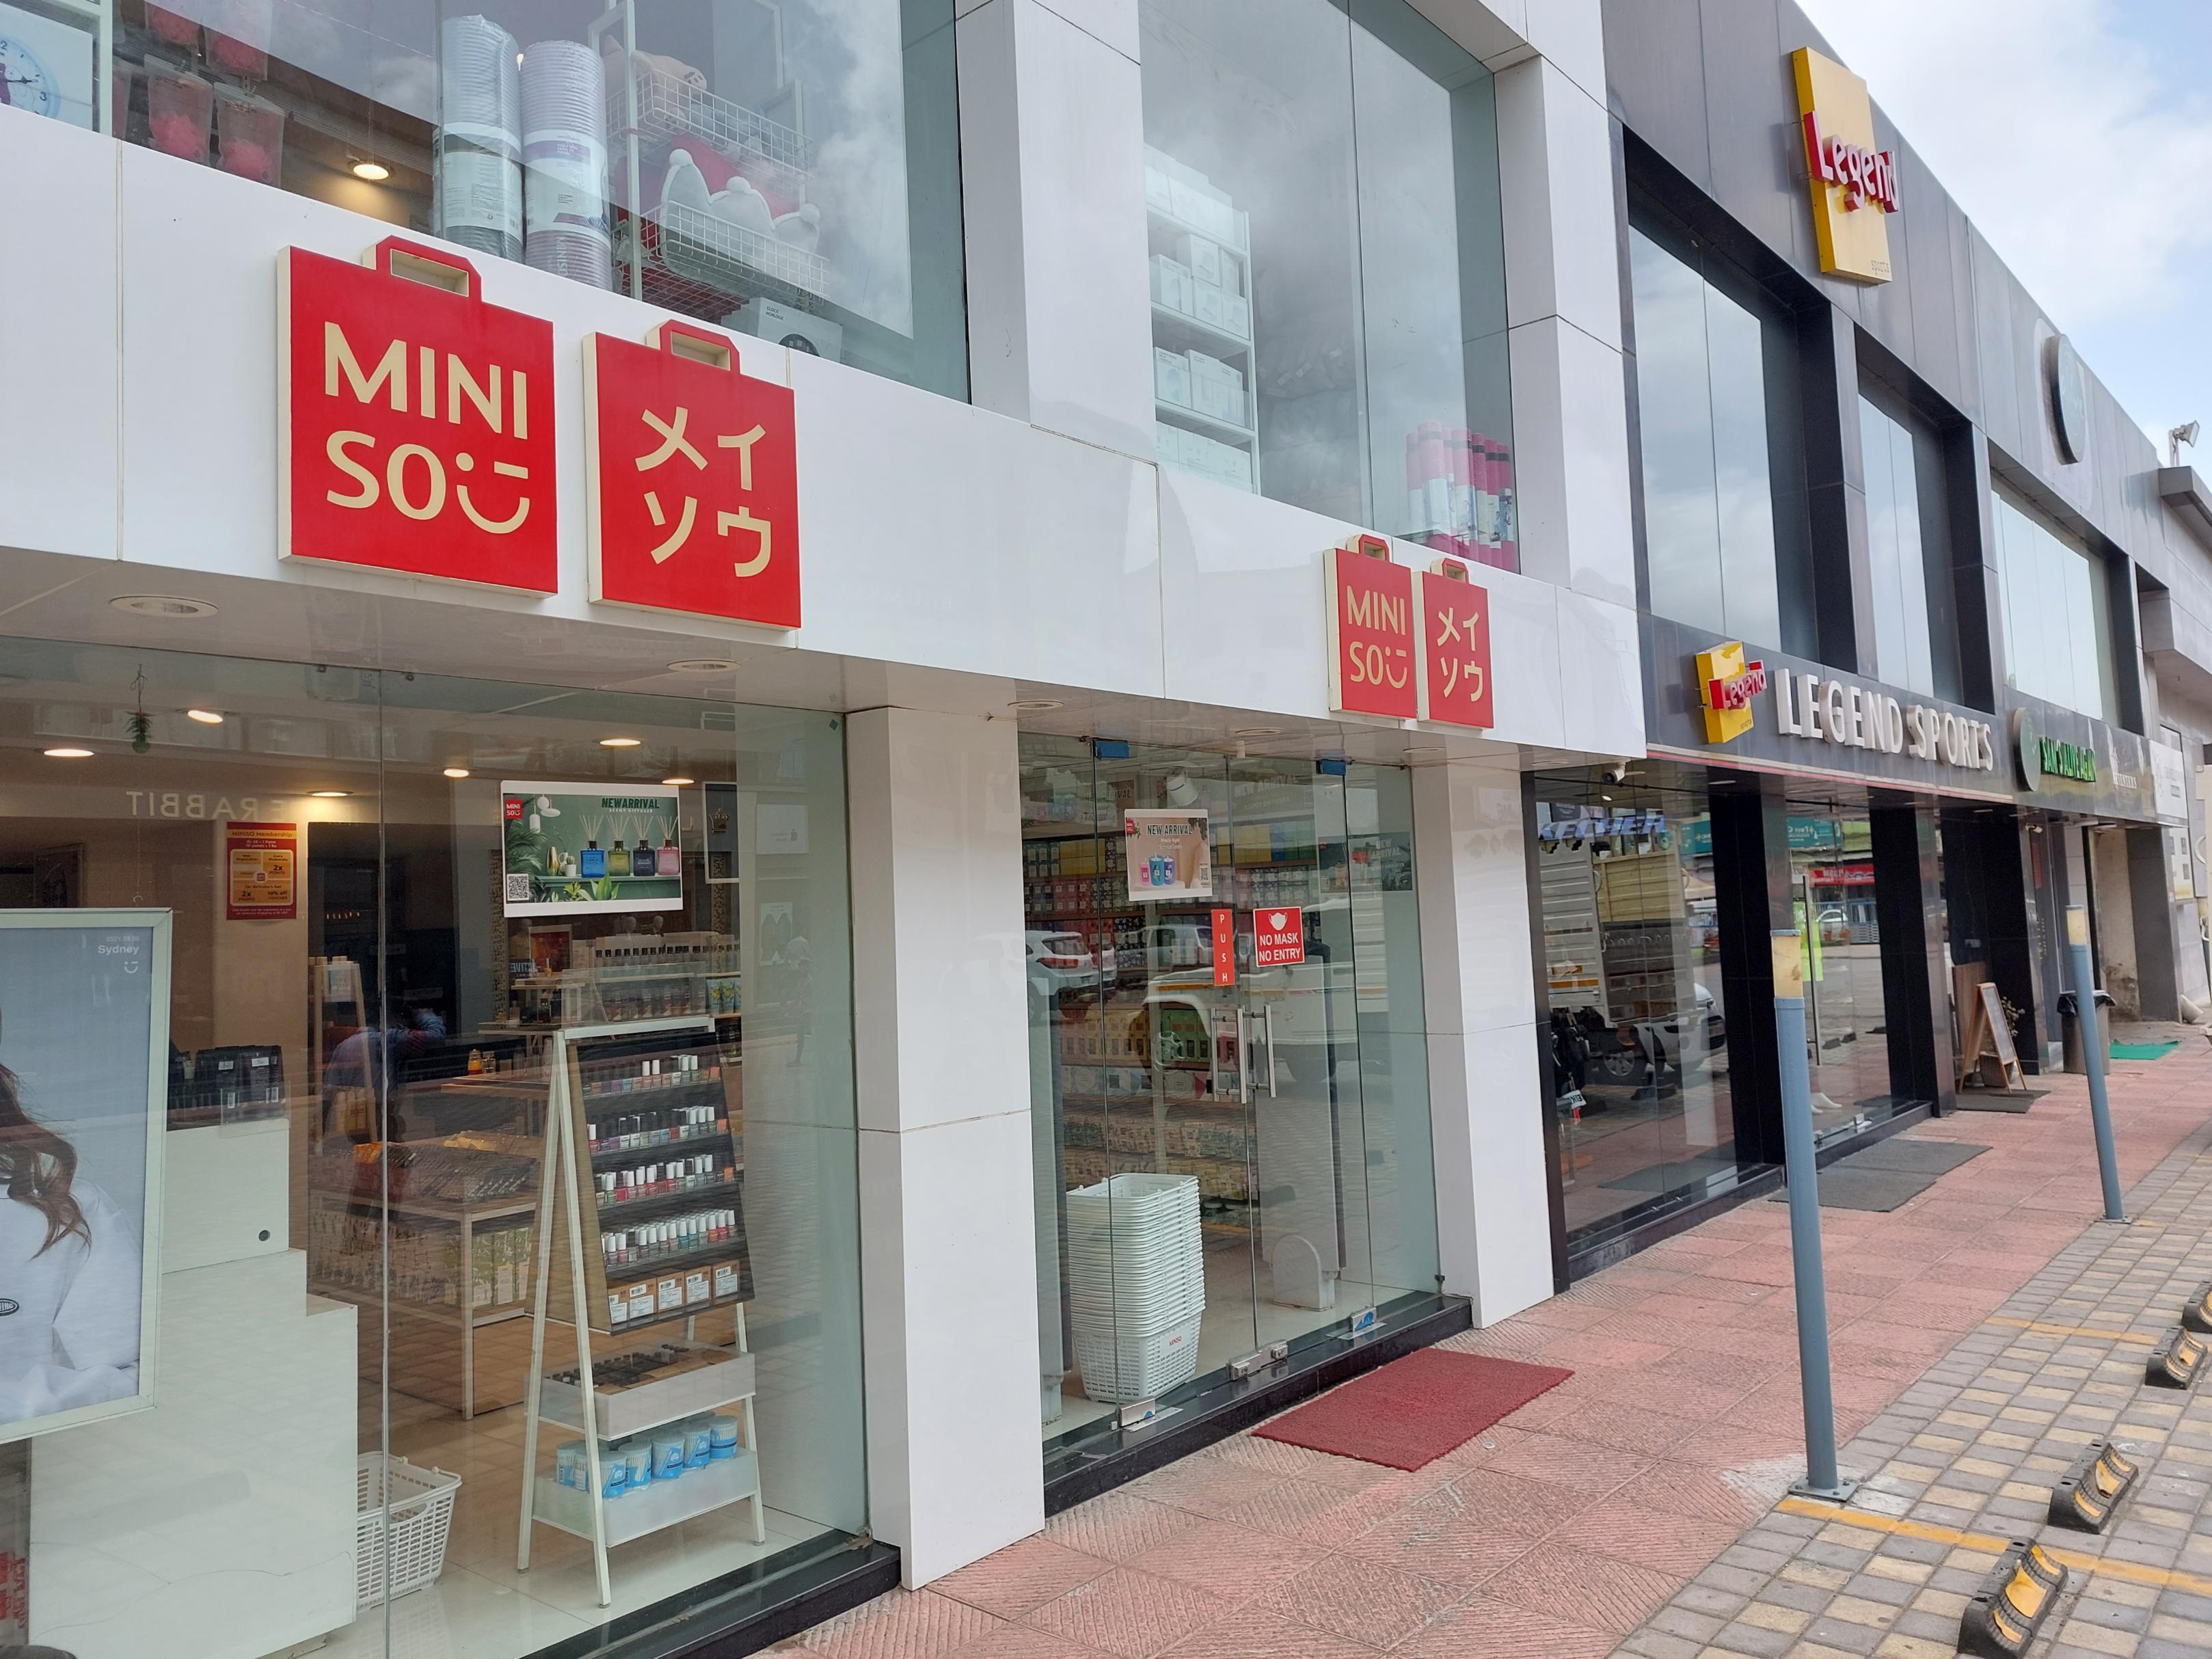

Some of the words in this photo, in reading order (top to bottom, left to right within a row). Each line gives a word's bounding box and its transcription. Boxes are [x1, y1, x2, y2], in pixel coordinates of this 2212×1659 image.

[1804, 110, 1900, 214] Legend
[325, 322, 528, 440] MINI
[1347, 585, 1406, 636] MINI
[1709, 660, 1767, 710] Legend
[1775, 669, 1904, 754] LEGEND
[1907, 705, 1993, 771] SPORTS
[1148, 824, 1162, 835] NEW
[1164, 824, 1192, 835] ARRIVAL
[98, 945, 139, 956] Sydney
[1259, 950, 1272, 962] NO
[1273, 947, 1301, 960] ENTRY
[1260, 934, 1272, 946] NO
[1274, 932, 1299, 945] MASK
